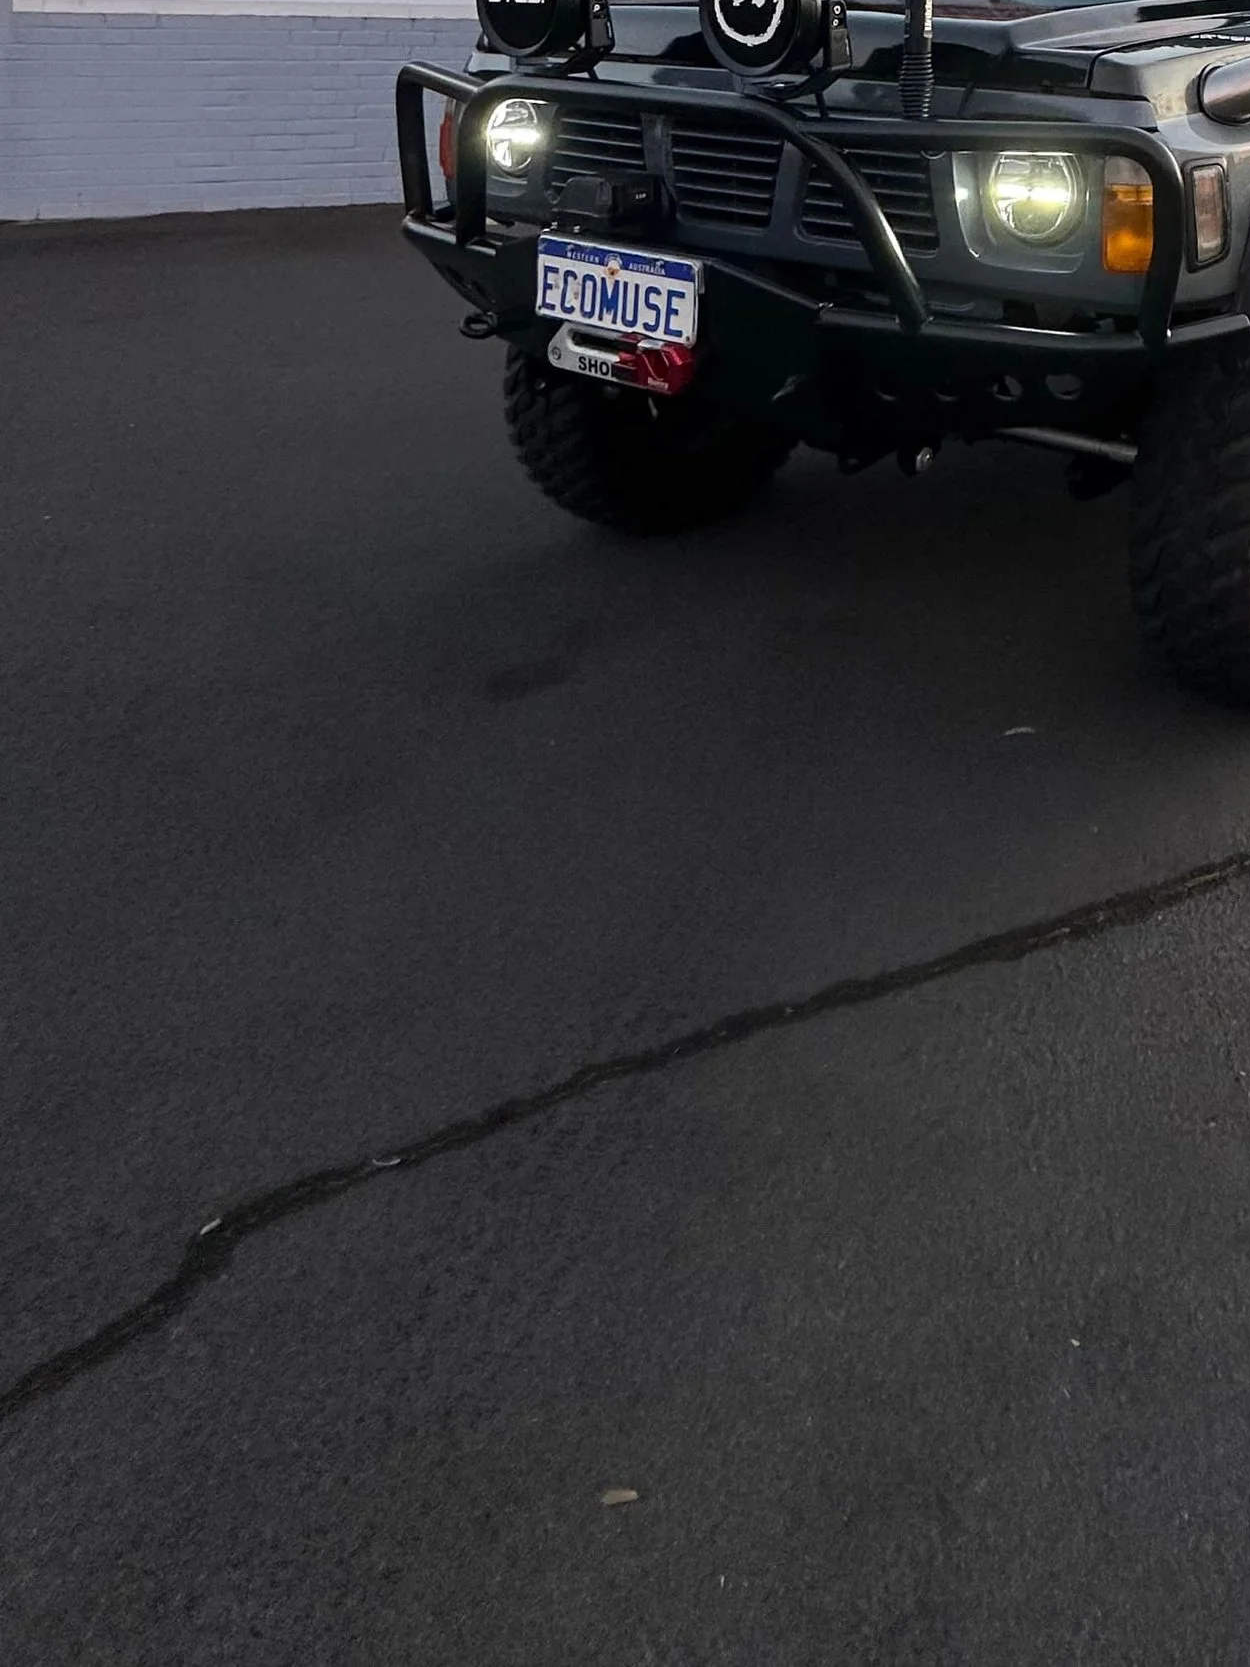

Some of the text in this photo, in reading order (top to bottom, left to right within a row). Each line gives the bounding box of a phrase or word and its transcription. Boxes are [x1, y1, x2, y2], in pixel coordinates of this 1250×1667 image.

[566, 251, 666, 276] WESTERN AUSTRALIA
[540, 262, 686, 337] ECOMUSE
